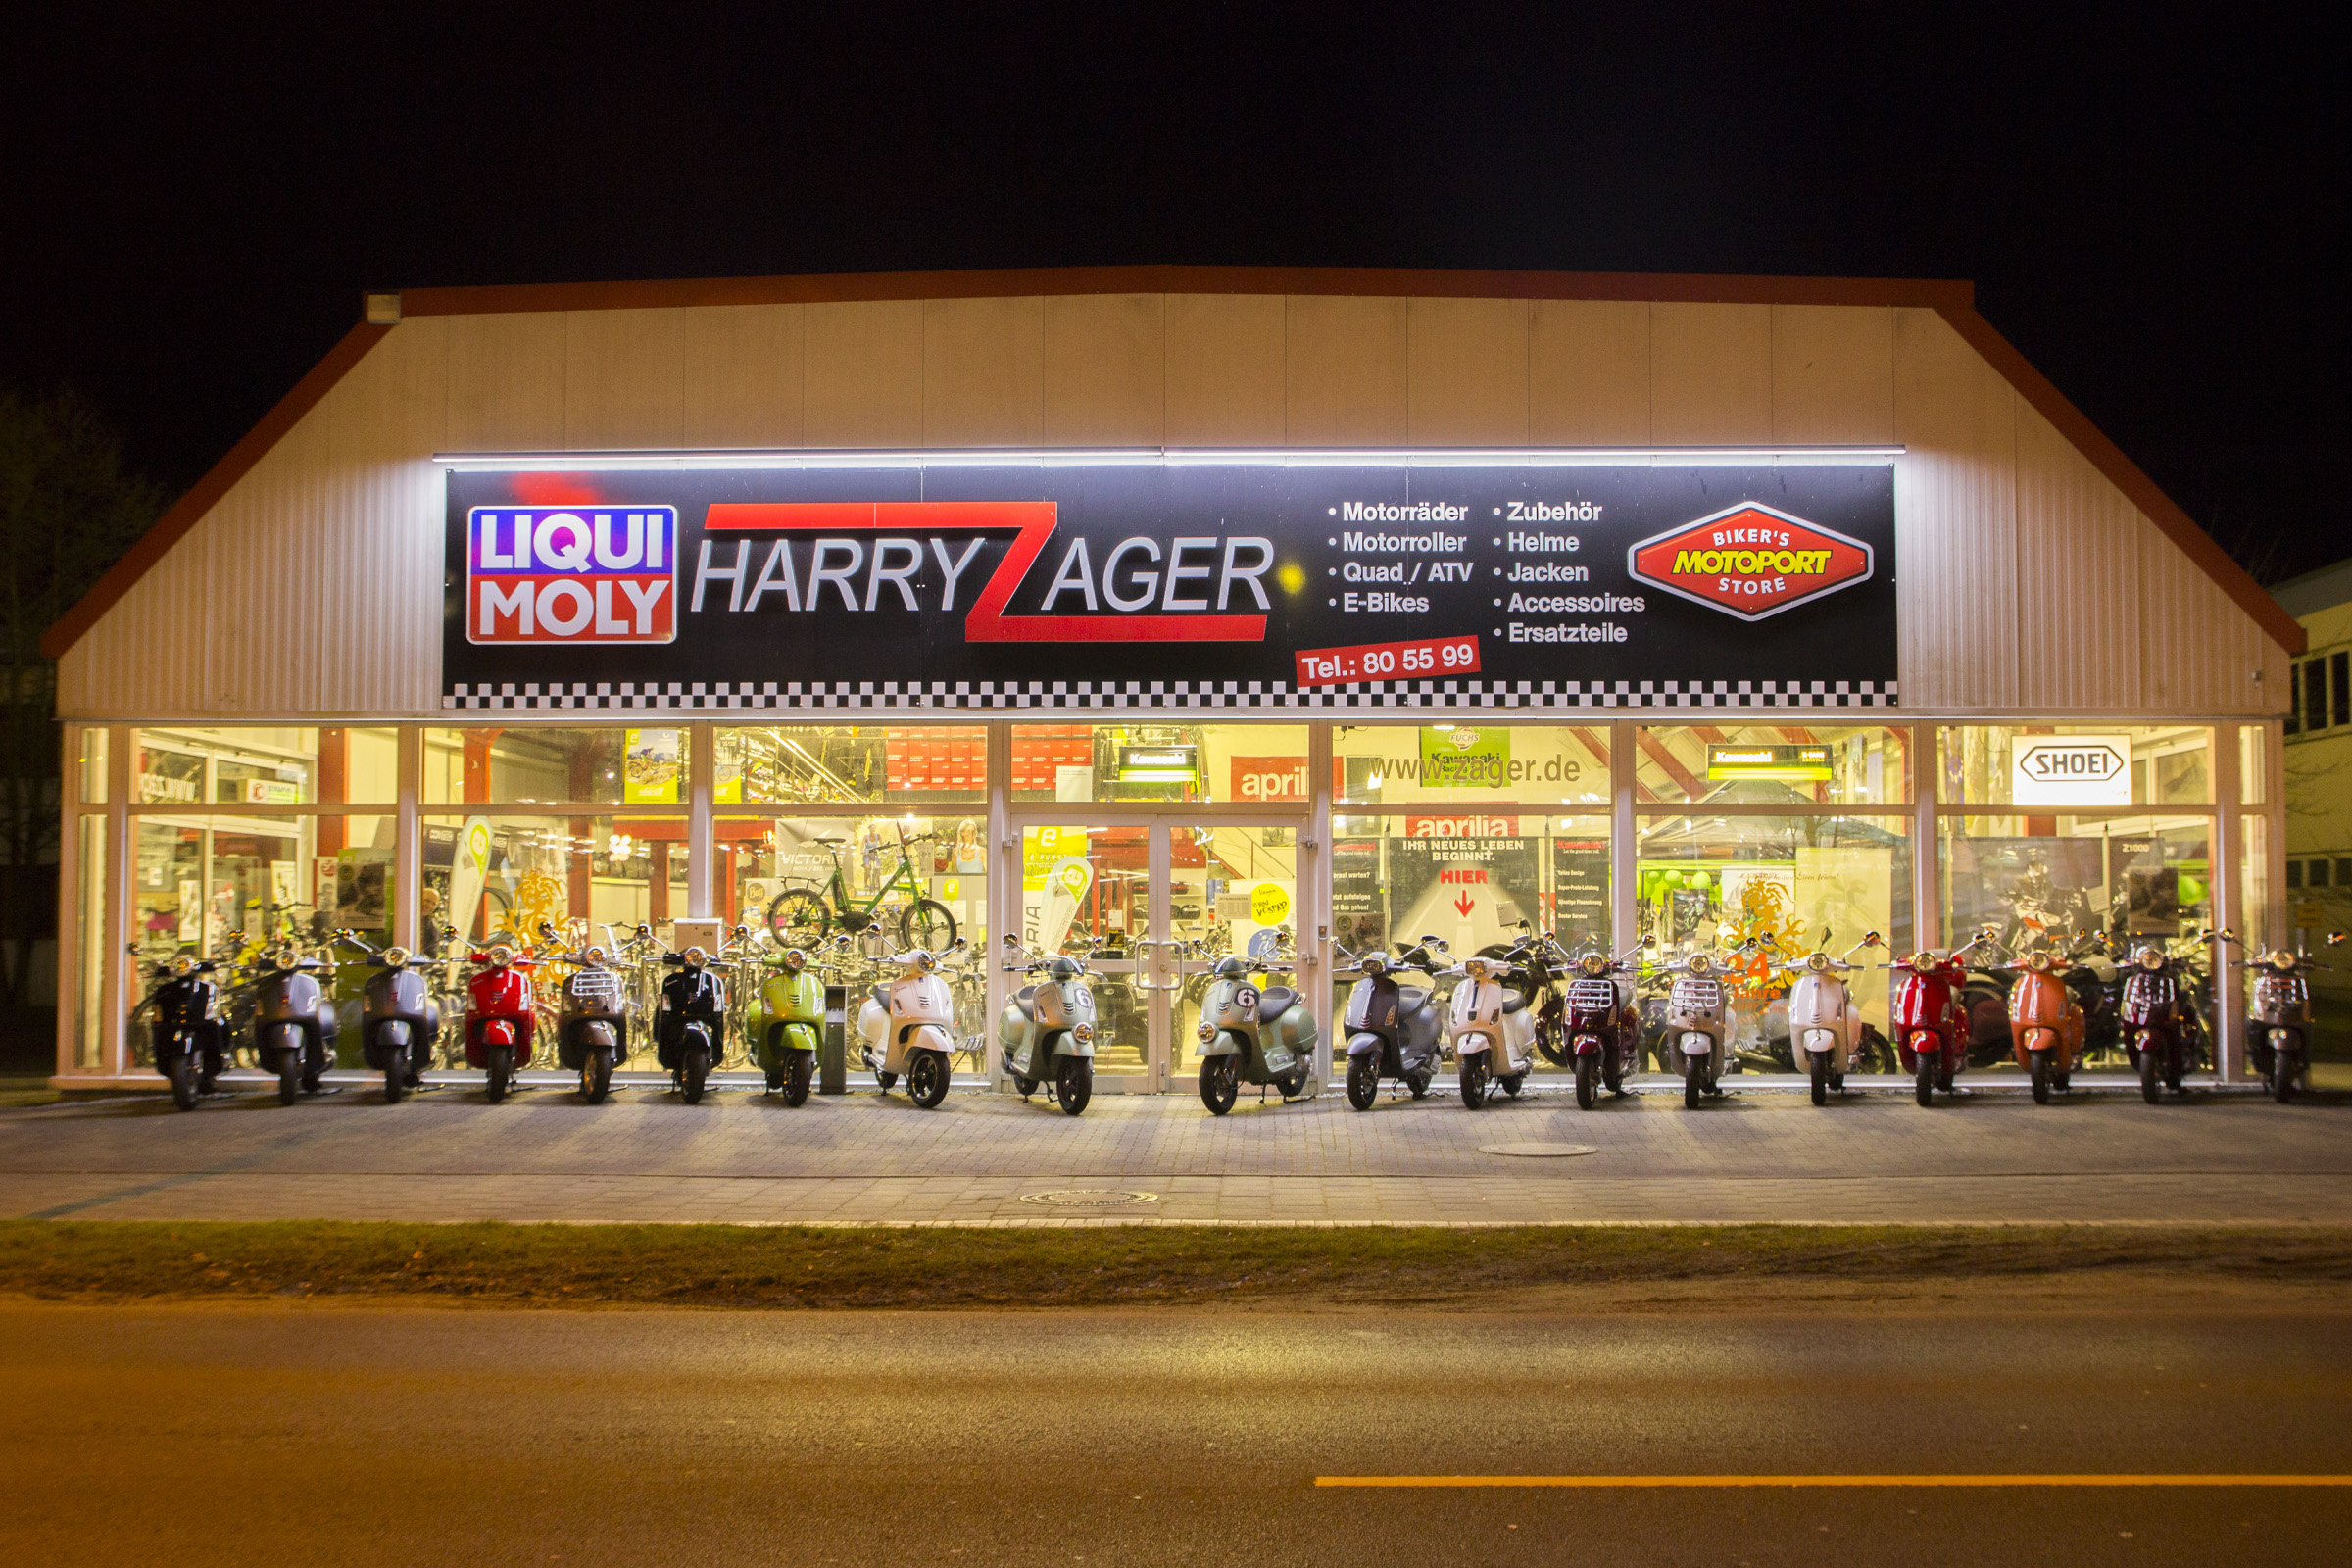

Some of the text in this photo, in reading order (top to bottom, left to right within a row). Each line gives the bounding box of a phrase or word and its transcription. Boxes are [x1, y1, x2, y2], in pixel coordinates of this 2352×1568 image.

[1343, 501, 1469, 521] Motorräder
[1507, 501, 1603, 521] Zubehör
[480, 513, 663, 573] LIQUI
[1343, 531, 1467, 552] Motorroller
[1508, 531, 1580, 552] Helme
[1712, 528, 1791, 547] BIKER'S
[691, 501, 1275, 642] HARRY ZAGER
[1343, 562, 1474, 582] Quad / ATV
[1507, 562, 1590, 582] Jacken
[1671, 549, 1833, 575] MOTOPORT
[1718, 576, 1787, 595] STORE
[480, 579, 670, 637] MOLY
[1344, 592, 1430, 612] E-Bikes
[1507, 592, 1646, 612] Accessoires
[1509, 622, 1628, 643] Ersatzteile
[1301, 644, 1474, 679] Tel.: 80 55 99
[1449, 733, 1480, 743] FUCHS
[1371, 754, 1581, 788] www.zager.de
[2036, 753, 2108, 775] SHOEI
[1416, 815, 1509, 837] aprilia
[1402, 840, 1525, 851] IHR NEUES LEBEN
[782, 854, 844, 865] VICTORIA
[1432, 851, 1495, 861] BEGINNT.
[1440, 869, 1489, 884] HIER
[1722, 952, 1771, 984] 24
[1237, 988, 1256, 1008] 6
[1733, 986, 1782, 1000] Jahre
